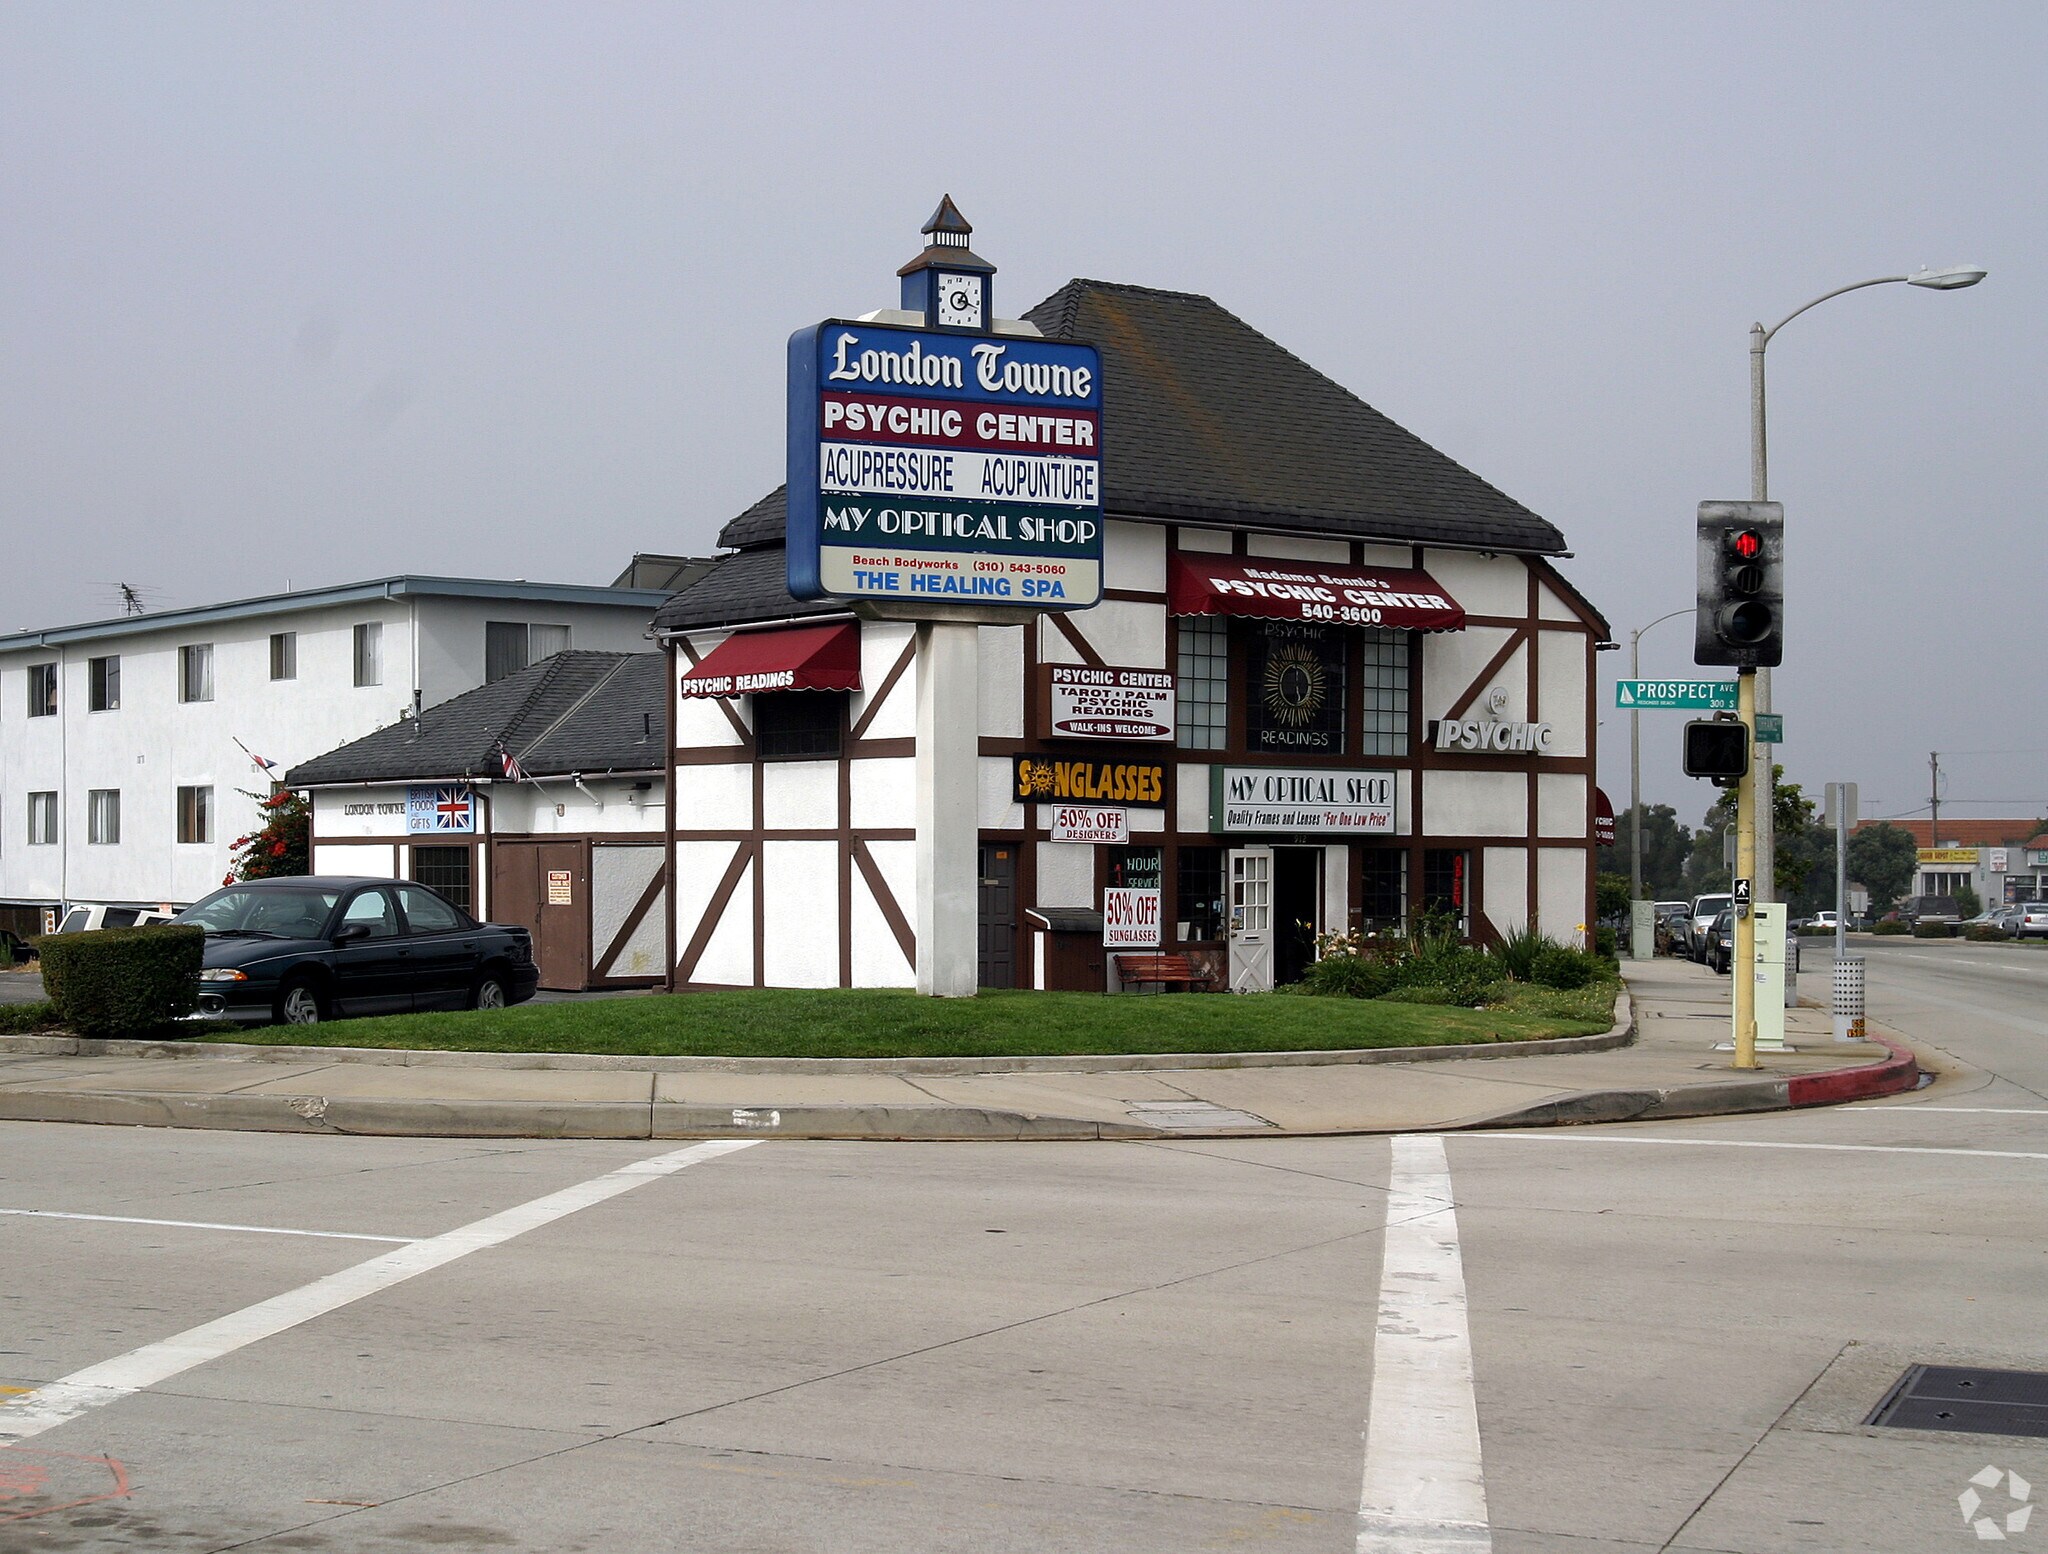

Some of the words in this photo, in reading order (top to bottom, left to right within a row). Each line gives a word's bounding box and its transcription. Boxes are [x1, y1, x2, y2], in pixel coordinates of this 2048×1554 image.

[828, 332, 964, 389] London
[970, 343, 1092, 398] Towne
[824, 401, 962, 438] PSYCHIC
[976, 411, 1094, 447] CENTER
[824, 448, 954, 492] ACUPRESSURE
[981, 457, 1095, 500] ACUPUNTURE
[823, 506, 872, 532] MY
[877, 508, 1012, 541] OPTICAL
[1019, 516, 1096, 544] SHOP
[853, 555, 890, 566] Beach
[894, 557, 959, 570] Bodyworks
[973, 561, 1005, 573] (310)
[1009, 563, 1066, 575] 543-5060
[853, 570, 899, 591] THE
[911, 574, 1011, 596] HEALING
[1022, 578, 1066, 598] SPA
[1243, 568, 1316, 583] Madame
[1318, 574, 1391, 588] Bonnie's
[1208, 578, 1336, 602] PSYCHIC
[1343, 589, 1453, 610] CENTER
[1302, 603, 1381, 623] 540-3600
[1265, 623, 1326, 640] PSYCHIC
[682, 676, 732, 694] PSYCHIC
[736, 670, 795, 690] READINGS
[1053, 668, 1114, 685] PSYCHIC
[1120, 672, 1172, 688] CENTER
[1059, 688, 1111, 697] TAROT
[1125, 691, 1167, 700] PALM
[1637, 683, 1716, 699] PROSPECT
[1719, 684, 1734, 693] AVE
[1078, 697, 1148, 708] PSYCHIC
[1710, 699, 1724, 708] 300
[1729, 699, 1735, 708] S
[1072, 706, 1154, 718] READINGS
[1069, 722, 1112, 733] WALK-INS
[1115, 724, 1157, 735] WELCOME
[1261, 730, 1329, 746] READINGS
[1229, 776, 1258, 800] MY
[1264, 776, 1339, 803] OPTICAL
[1346, 778, 1391, 803] SHOP
[344, 804, 374, 816] LONDON
[377, 803, 405, 815] TOWNE
[411, 800, 435, 811] FOODS
[411, 818, 431, 829] GIFTS
[1060, 809, 1092, 828] 50%
[1096, 812, 1121, 829] OFF
[1228, 810, 1253, 827] Quality
[1255, 810, 1280, 825] Frames
[1282, 811, 1296, 825] and
[1296, 811, 1320, 825] Lenses
[1339, 812, 1352, 825] One
[1354, 812, 1367, 826] Low
[1066, 830, 1117, 839] DESIGNERS
[1127, 857, 1159, 871] HOUR
[1107, 892, 1133, 925] 50%
[1137, 896, 1157, 924] OFF
[1109, 930, 1156, 942] SUNGLASSES
